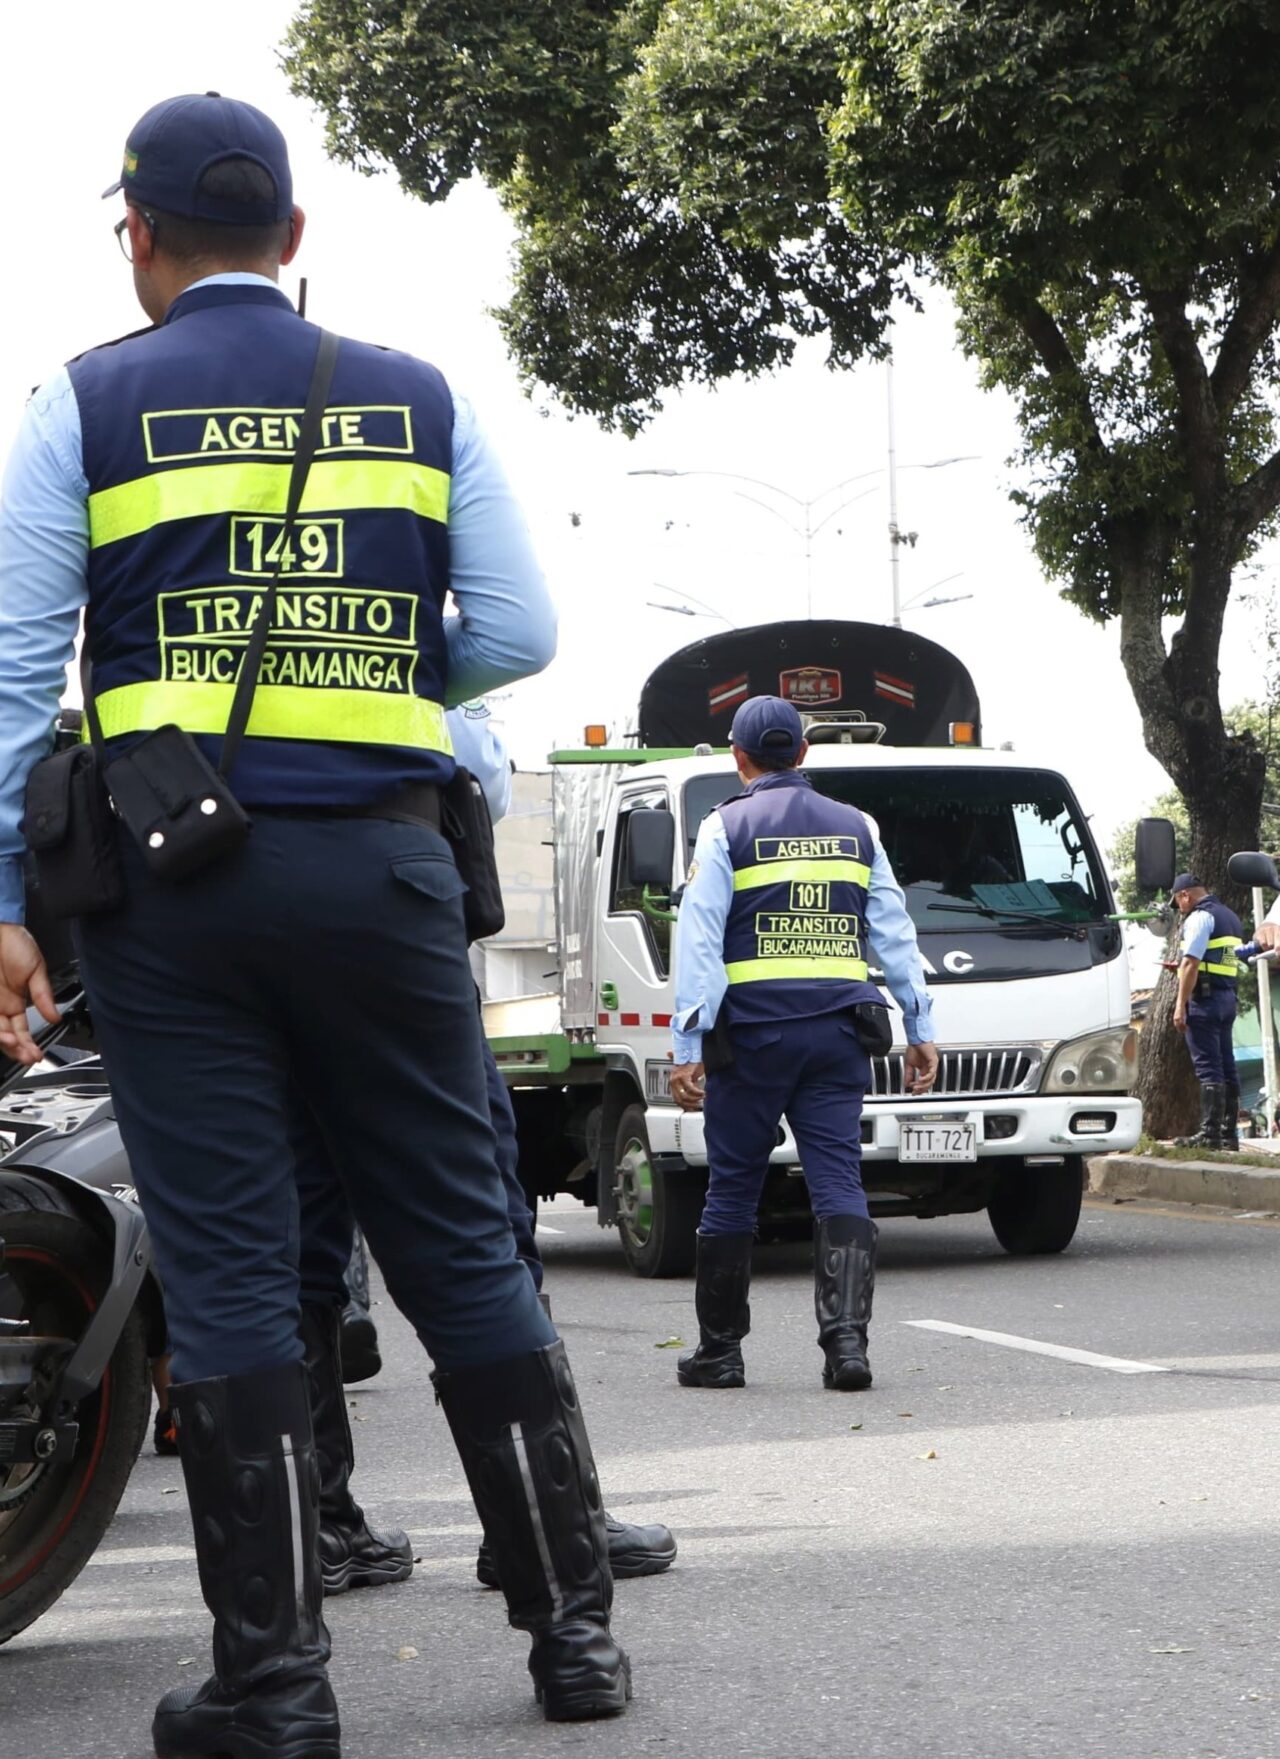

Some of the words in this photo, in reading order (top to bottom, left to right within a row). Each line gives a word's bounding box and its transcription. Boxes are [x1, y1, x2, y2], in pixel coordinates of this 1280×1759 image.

[246, 522, 329, 572] 149
[777, 840, 841, 857] AGENTE
[797, 884, 824, 908] 101
[768, 917, 849, 934] TRANSITO
[763, 939, 856, 957] BUCARAMANGA
